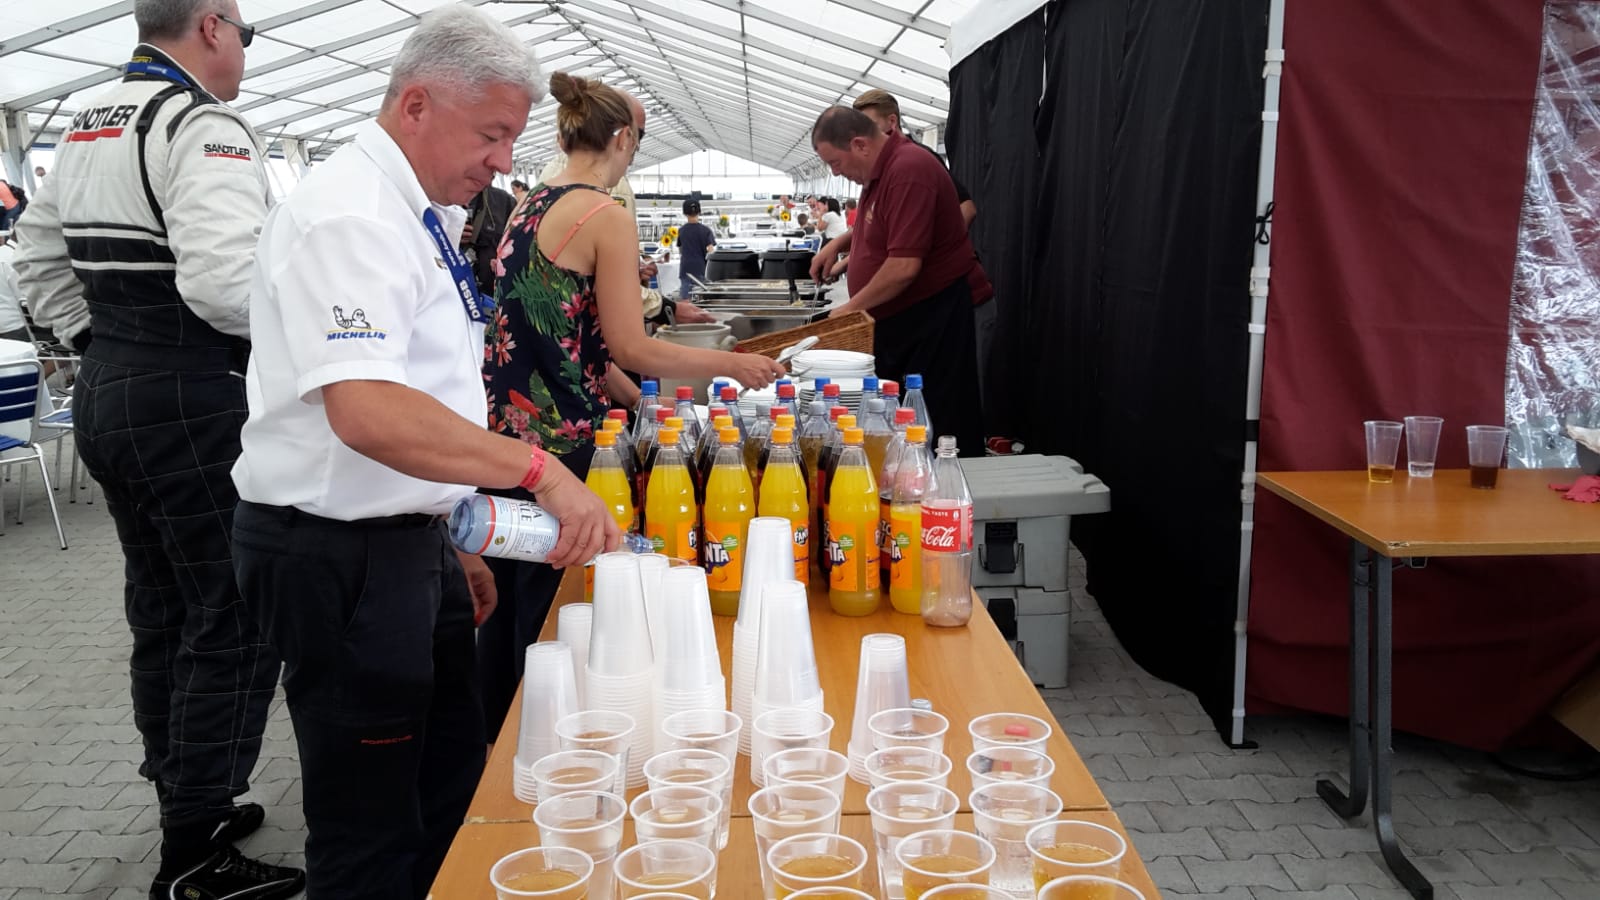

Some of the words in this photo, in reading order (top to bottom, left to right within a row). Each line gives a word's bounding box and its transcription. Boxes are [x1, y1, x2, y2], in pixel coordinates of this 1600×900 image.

[69, 105, 138, 132] SANDTLER
[203, 143, 250, 157] SANDTLER
[459, 279, 480, 319] DMSB
[327, 331, 386, 341] MICHELIN
[922, 526, 957, 547] Cola
[705, 542, 729, 563] NTA
